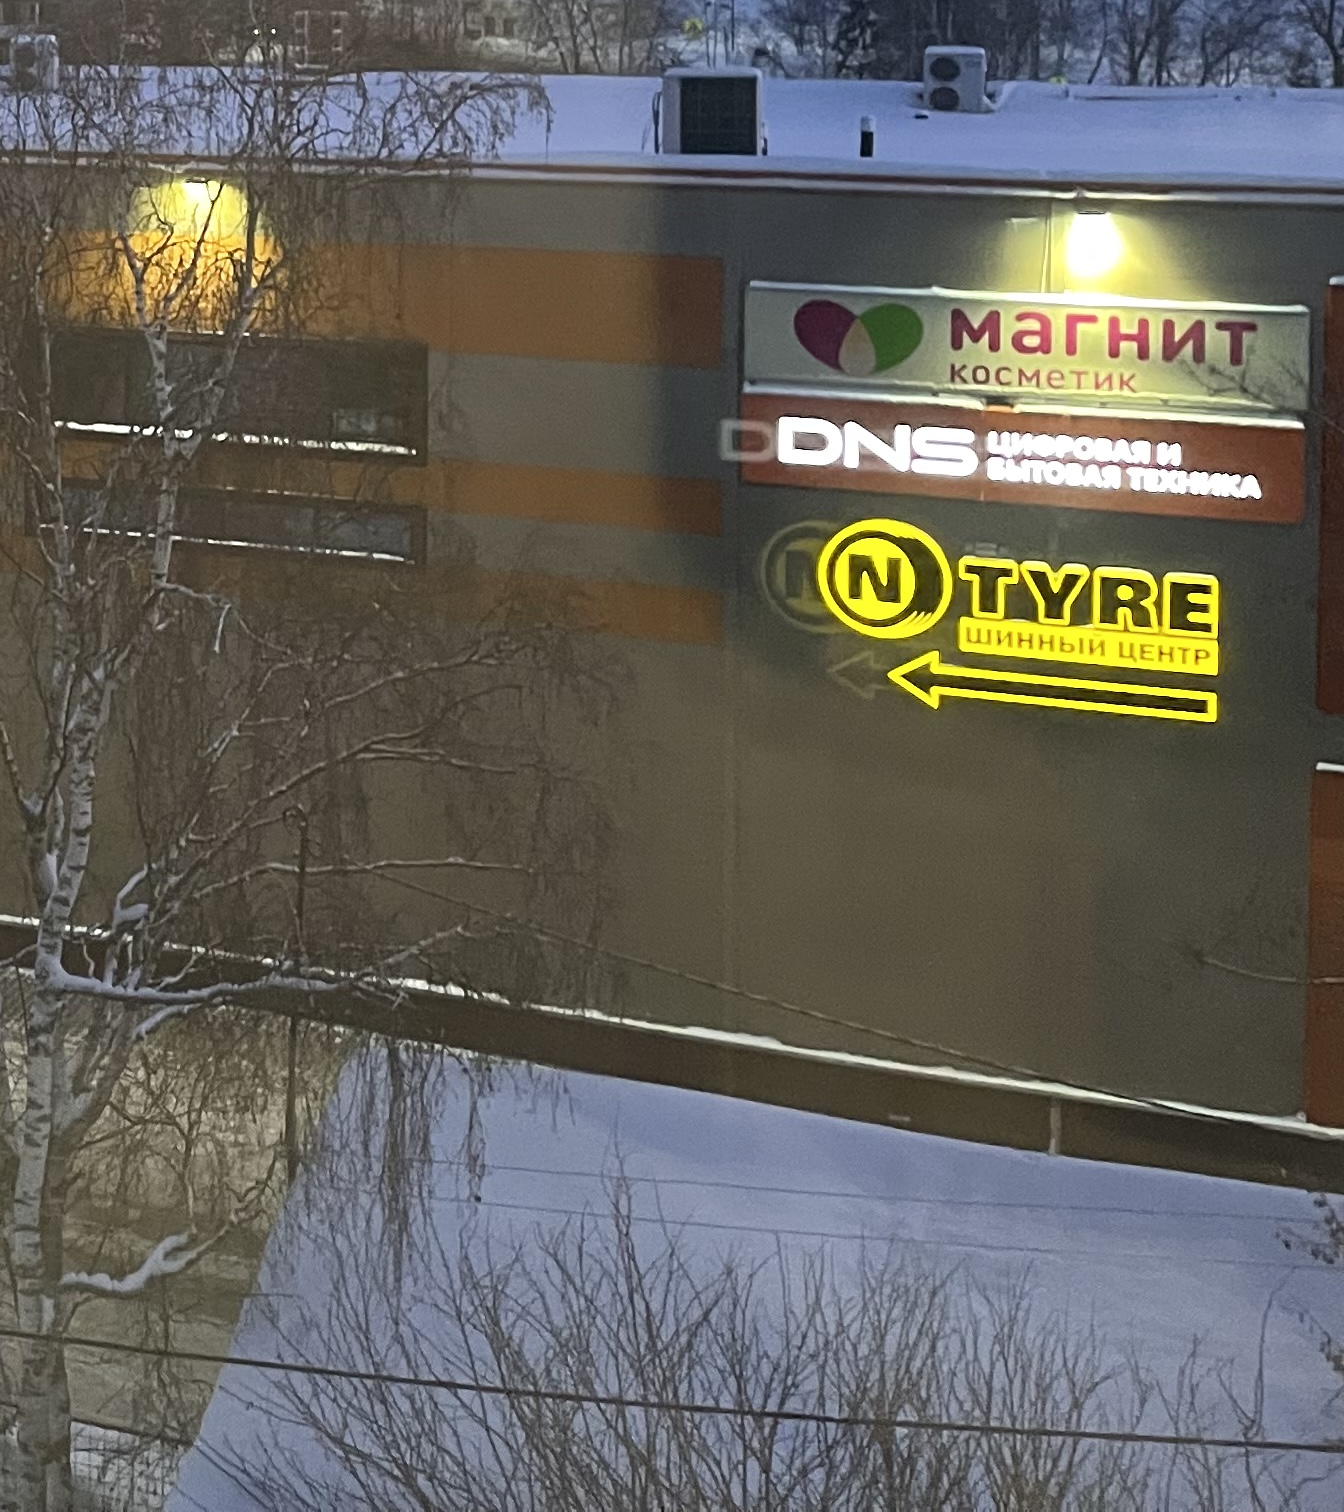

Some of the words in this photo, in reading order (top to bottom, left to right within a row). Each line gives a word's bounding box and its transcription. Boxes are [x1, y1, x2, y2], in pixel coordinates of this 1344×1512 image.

[776, 416, 979, 478] DNS
[987, 430, 1153, 466] ЦИФРОВАЯ
[1157, 441, 1182, 467] И
[986, 456, 1122, 491] БЫТОВАЯ
[1125, 465, 1263, 501] ТЕХНИКА
[847, 553, 903, 604] N
[959, 556, 1219, 639] TYRE
[965, 626, 1107, 659] ШИННЫЙ
[1118, 640, 1212, 667] ЦЕНТР
